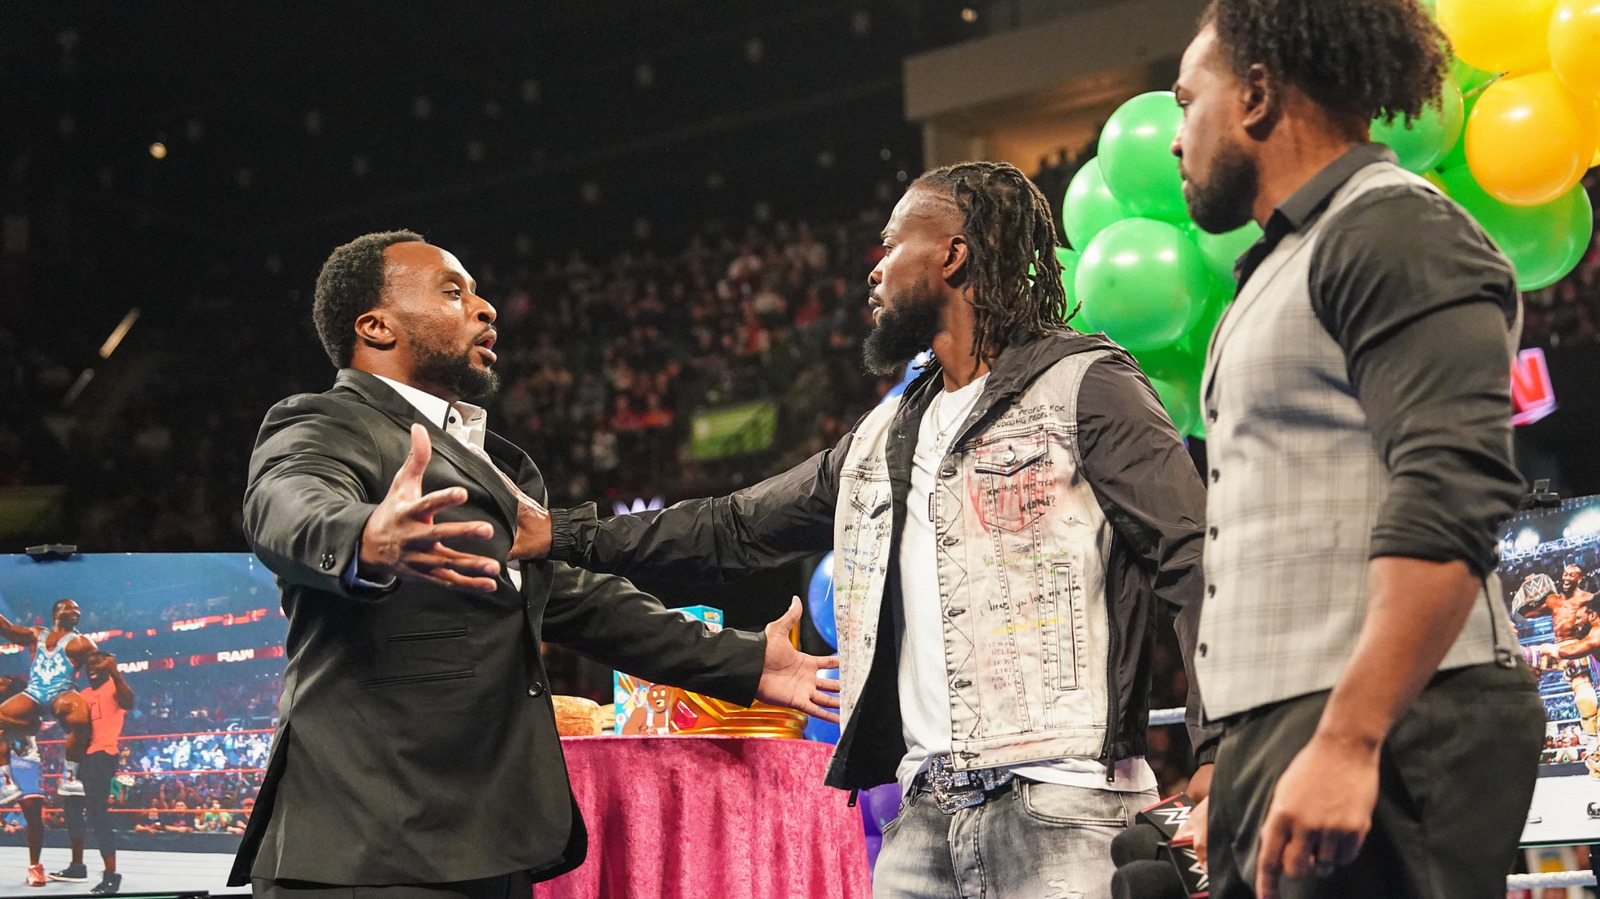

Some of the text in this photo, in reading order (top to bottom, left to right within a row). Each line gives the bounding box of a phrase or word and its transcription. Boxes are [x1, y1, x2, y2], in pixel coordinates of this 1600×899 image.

[1018, 404, 1047, 415] PEOPLE
[1049, 404, 1066, 413] FOR
[991, 412, 1054, 430] JUDGING PEOPLE
[1015, 598, 1028, 615] you
[217, 648, 255, 663] RAW
[116, 660, 149, 673] RAW
